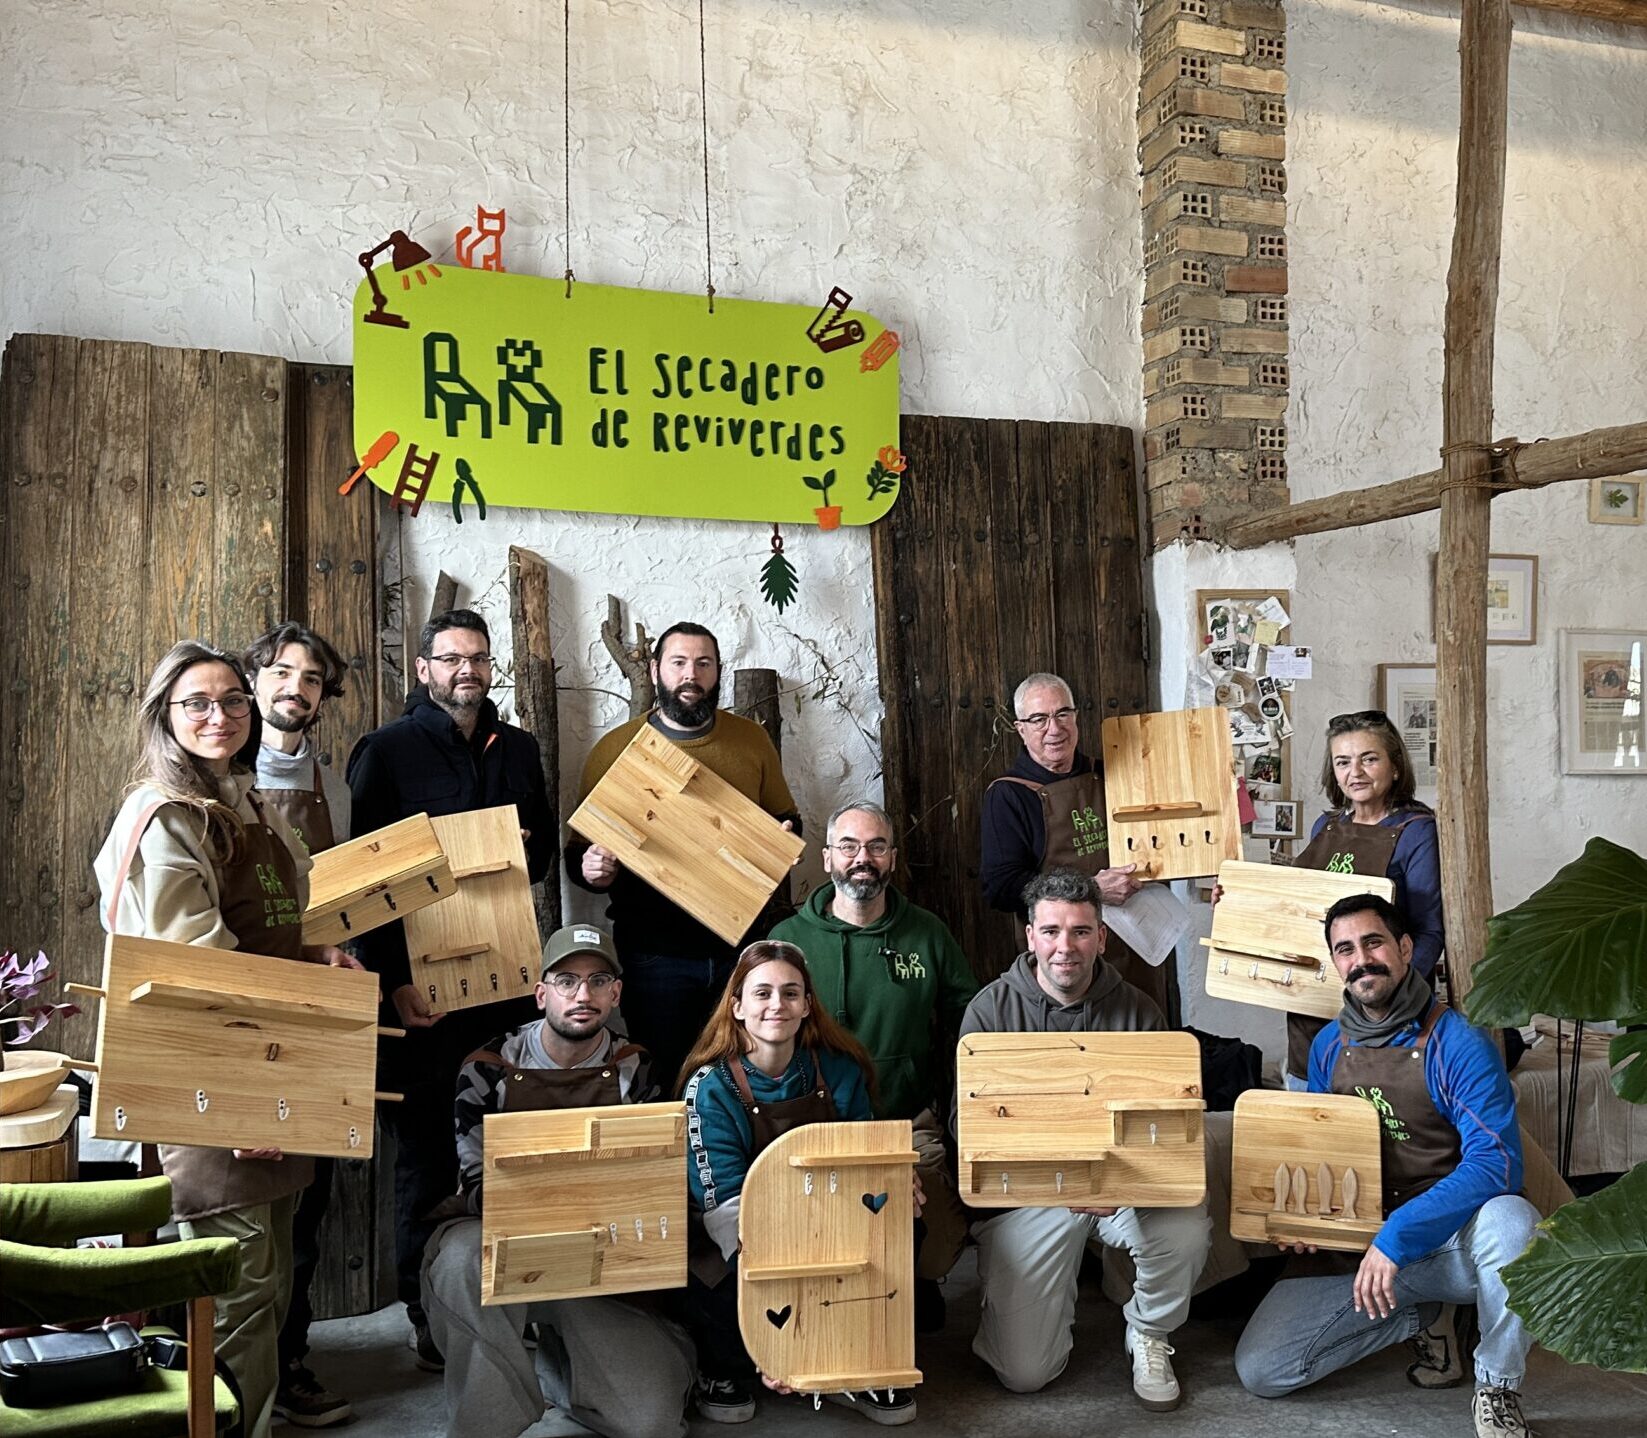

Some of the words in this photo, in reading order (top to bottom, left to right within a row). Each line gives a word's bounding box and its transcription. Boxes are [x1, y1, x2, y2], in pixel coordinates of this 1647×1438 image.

[589, 347, 629, 396] El
[652, 353, 825, 406] Secadero
[592, 408, 629, 449] de
[652, 412, 846, 462] Reviverdes
